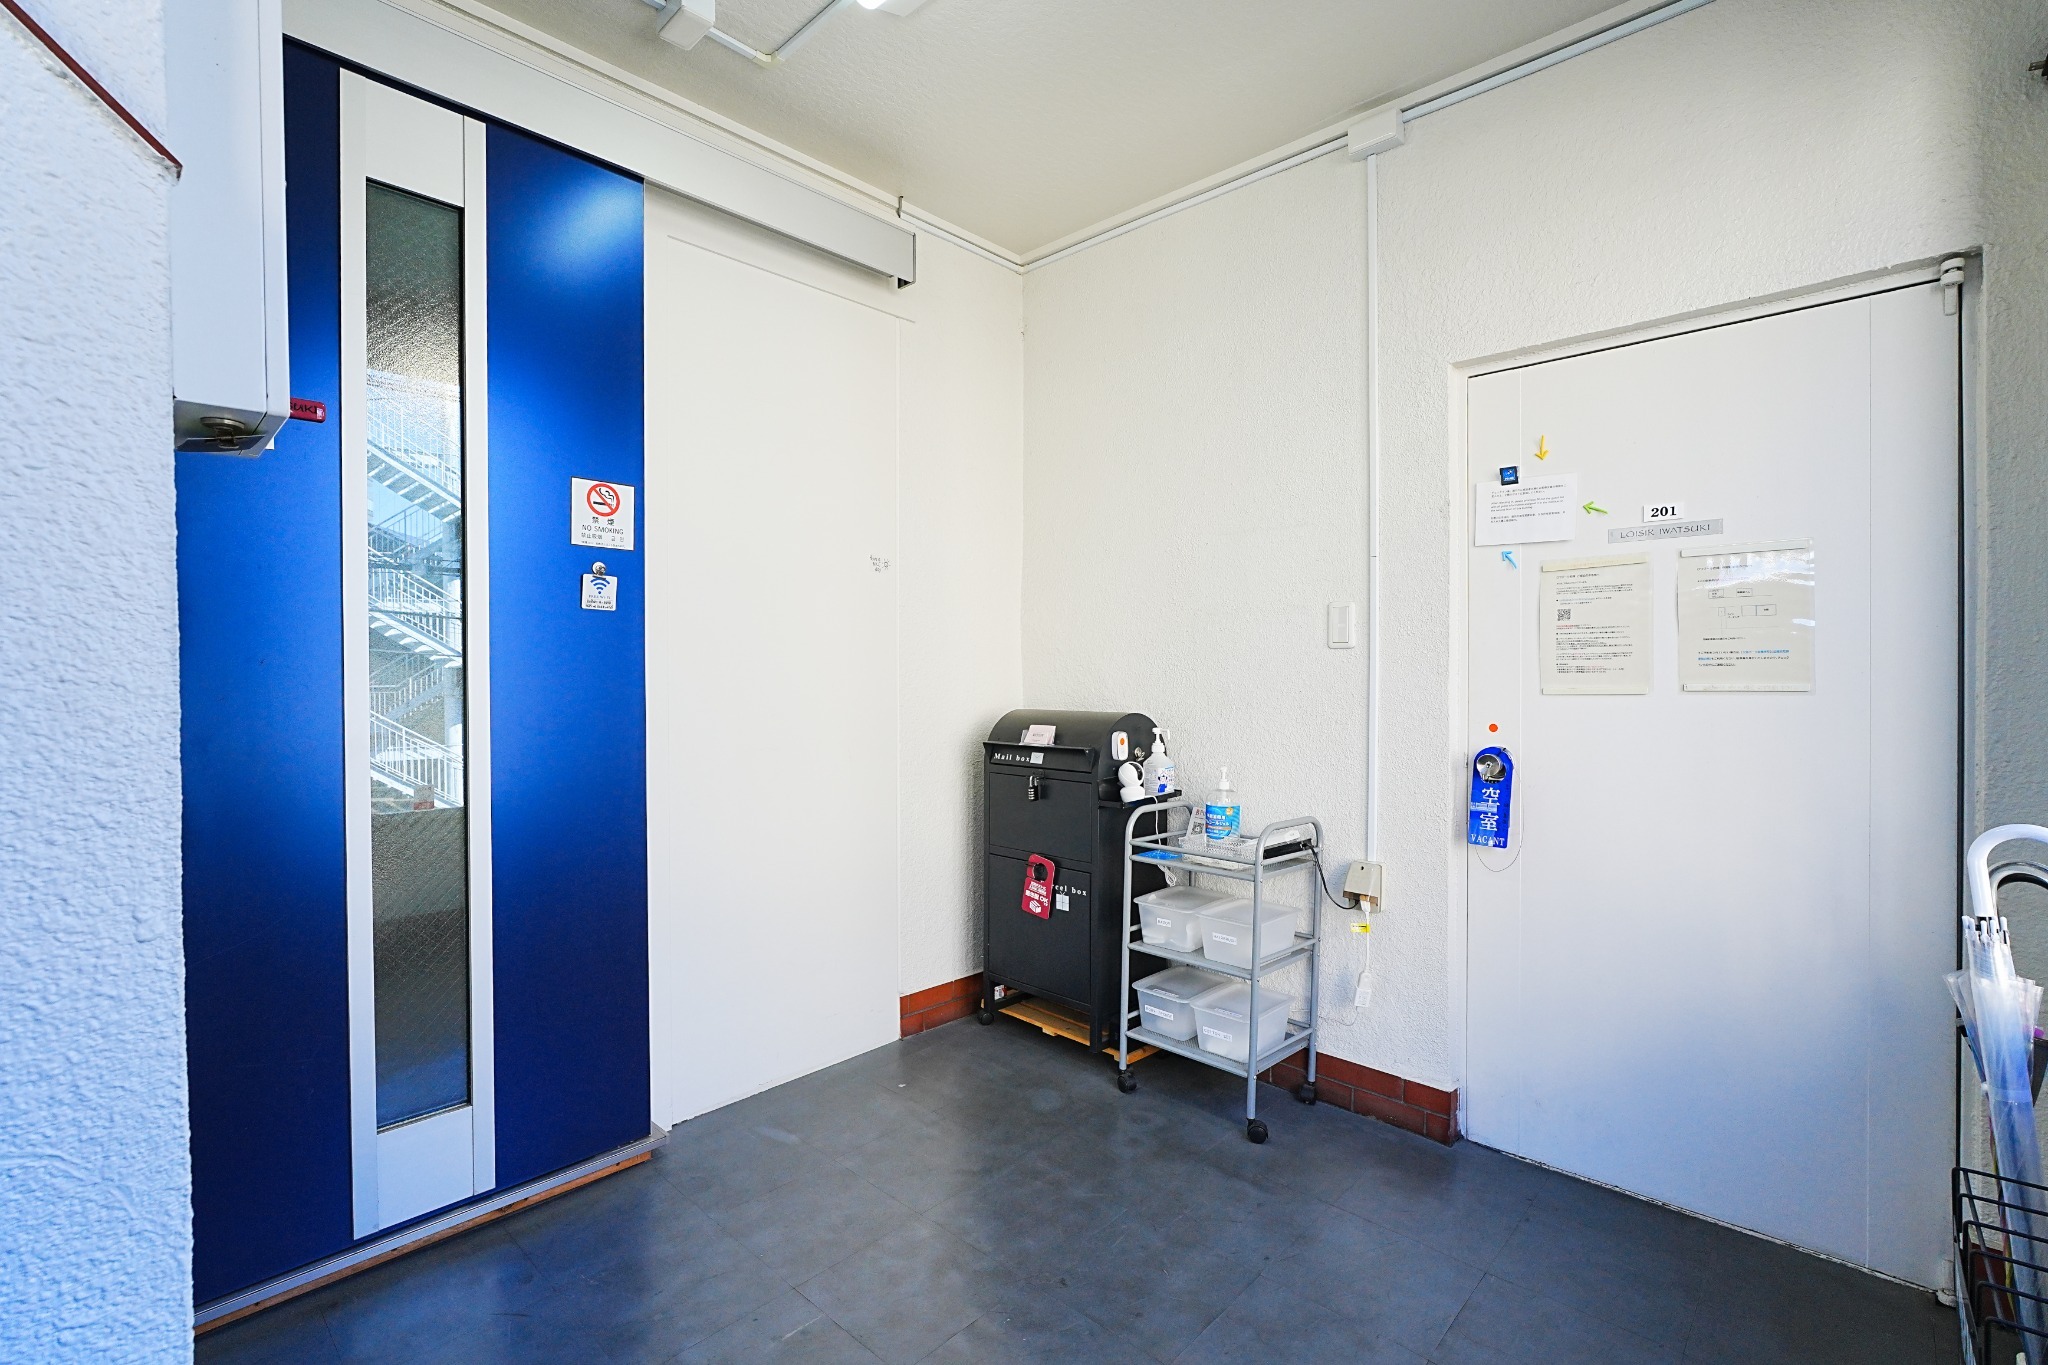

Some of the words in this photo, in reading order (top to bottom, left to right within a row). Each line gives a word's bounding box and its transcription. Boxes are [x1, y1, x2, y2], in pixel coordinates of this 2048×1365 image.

[1650, 506, 1677, 518] 201
[582, 524, 592, 532] NO
[594, 526, 624, 535] SMOKING
[1620, 529, 1655, 539] LOISIR
[1659, 524, 1711, 535] IWATSUKI
[993, 753, 1013, 761] Mail
[1479, 787, 1500, 831] 空室
[1470, 833, 1506, 846] VACANT
[1071, 887, 1087, 896] box
